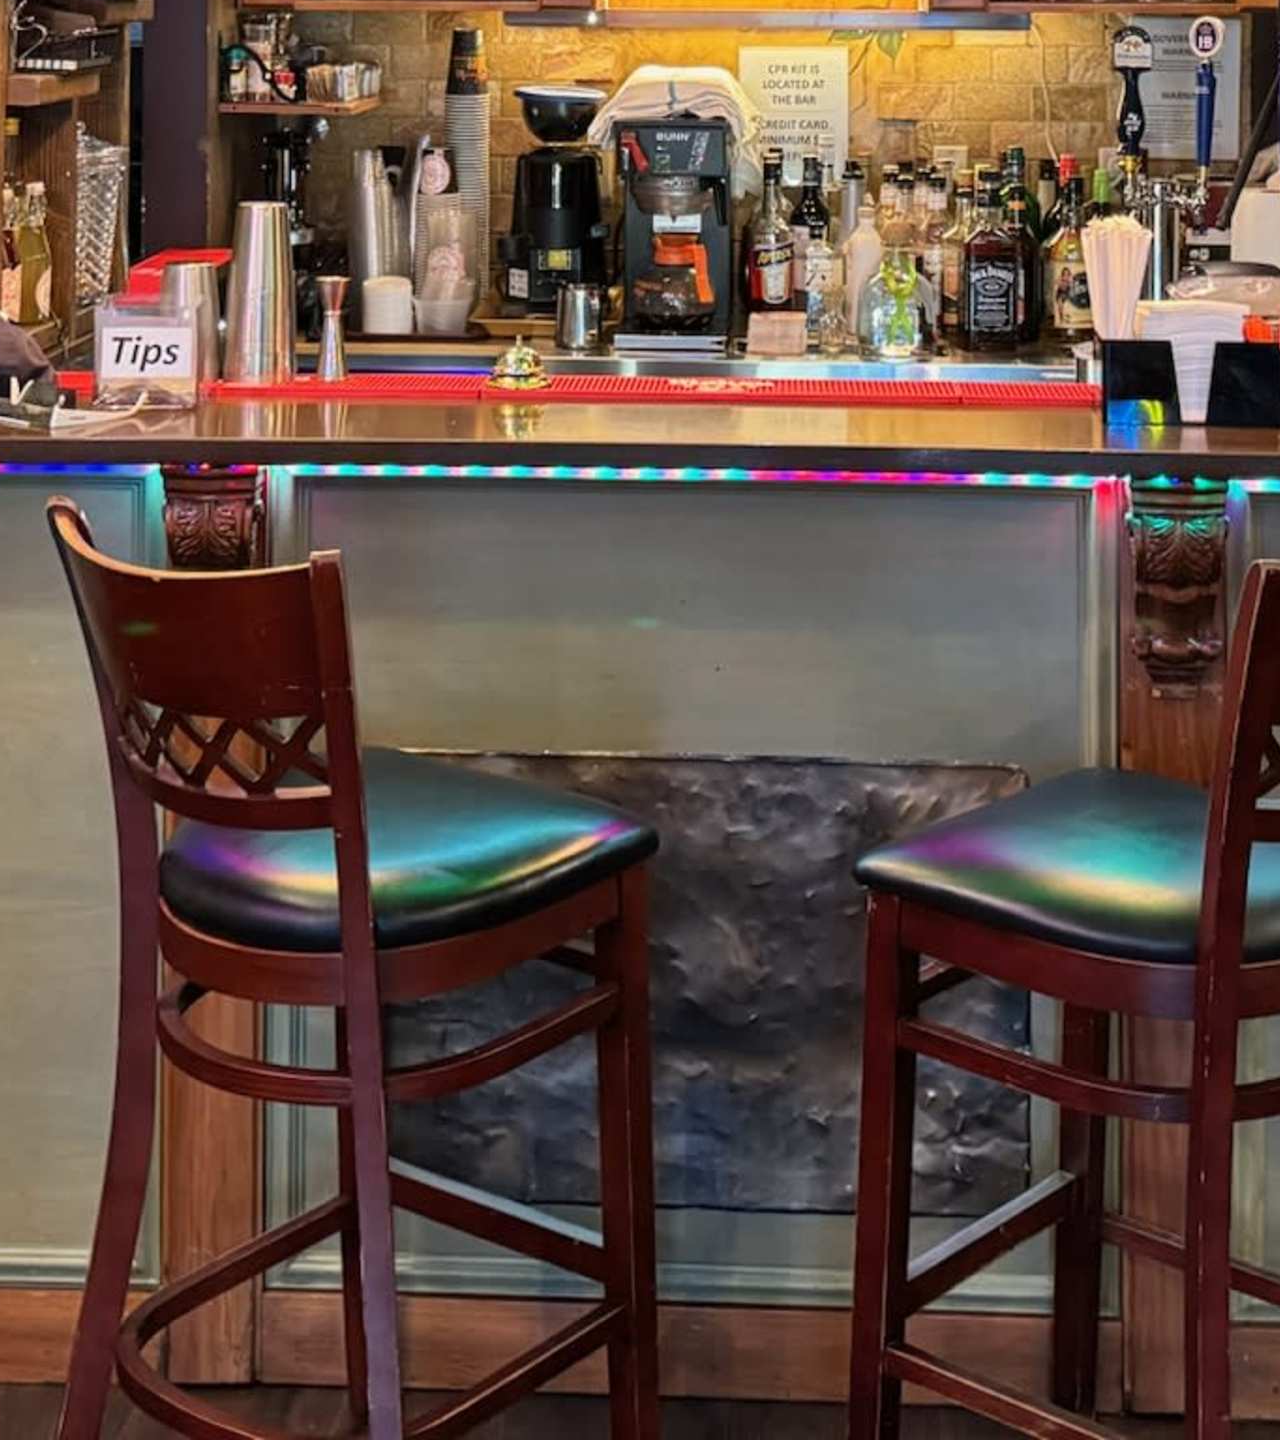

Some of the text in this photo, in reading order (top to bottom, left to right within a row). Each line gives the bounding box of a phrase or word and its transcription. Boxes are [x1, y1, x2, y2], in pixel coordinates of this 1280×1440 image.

[768, 64, 820, 74] CPR KIT IS
[762, 79, 825, 89] LOCATED AT
[771, 95, 816, 105] THE BAR
[799, 120, 829, 130] CARD
[656, 132, 690, 141] BUNN
[112, 336, 180, 372] Tips
